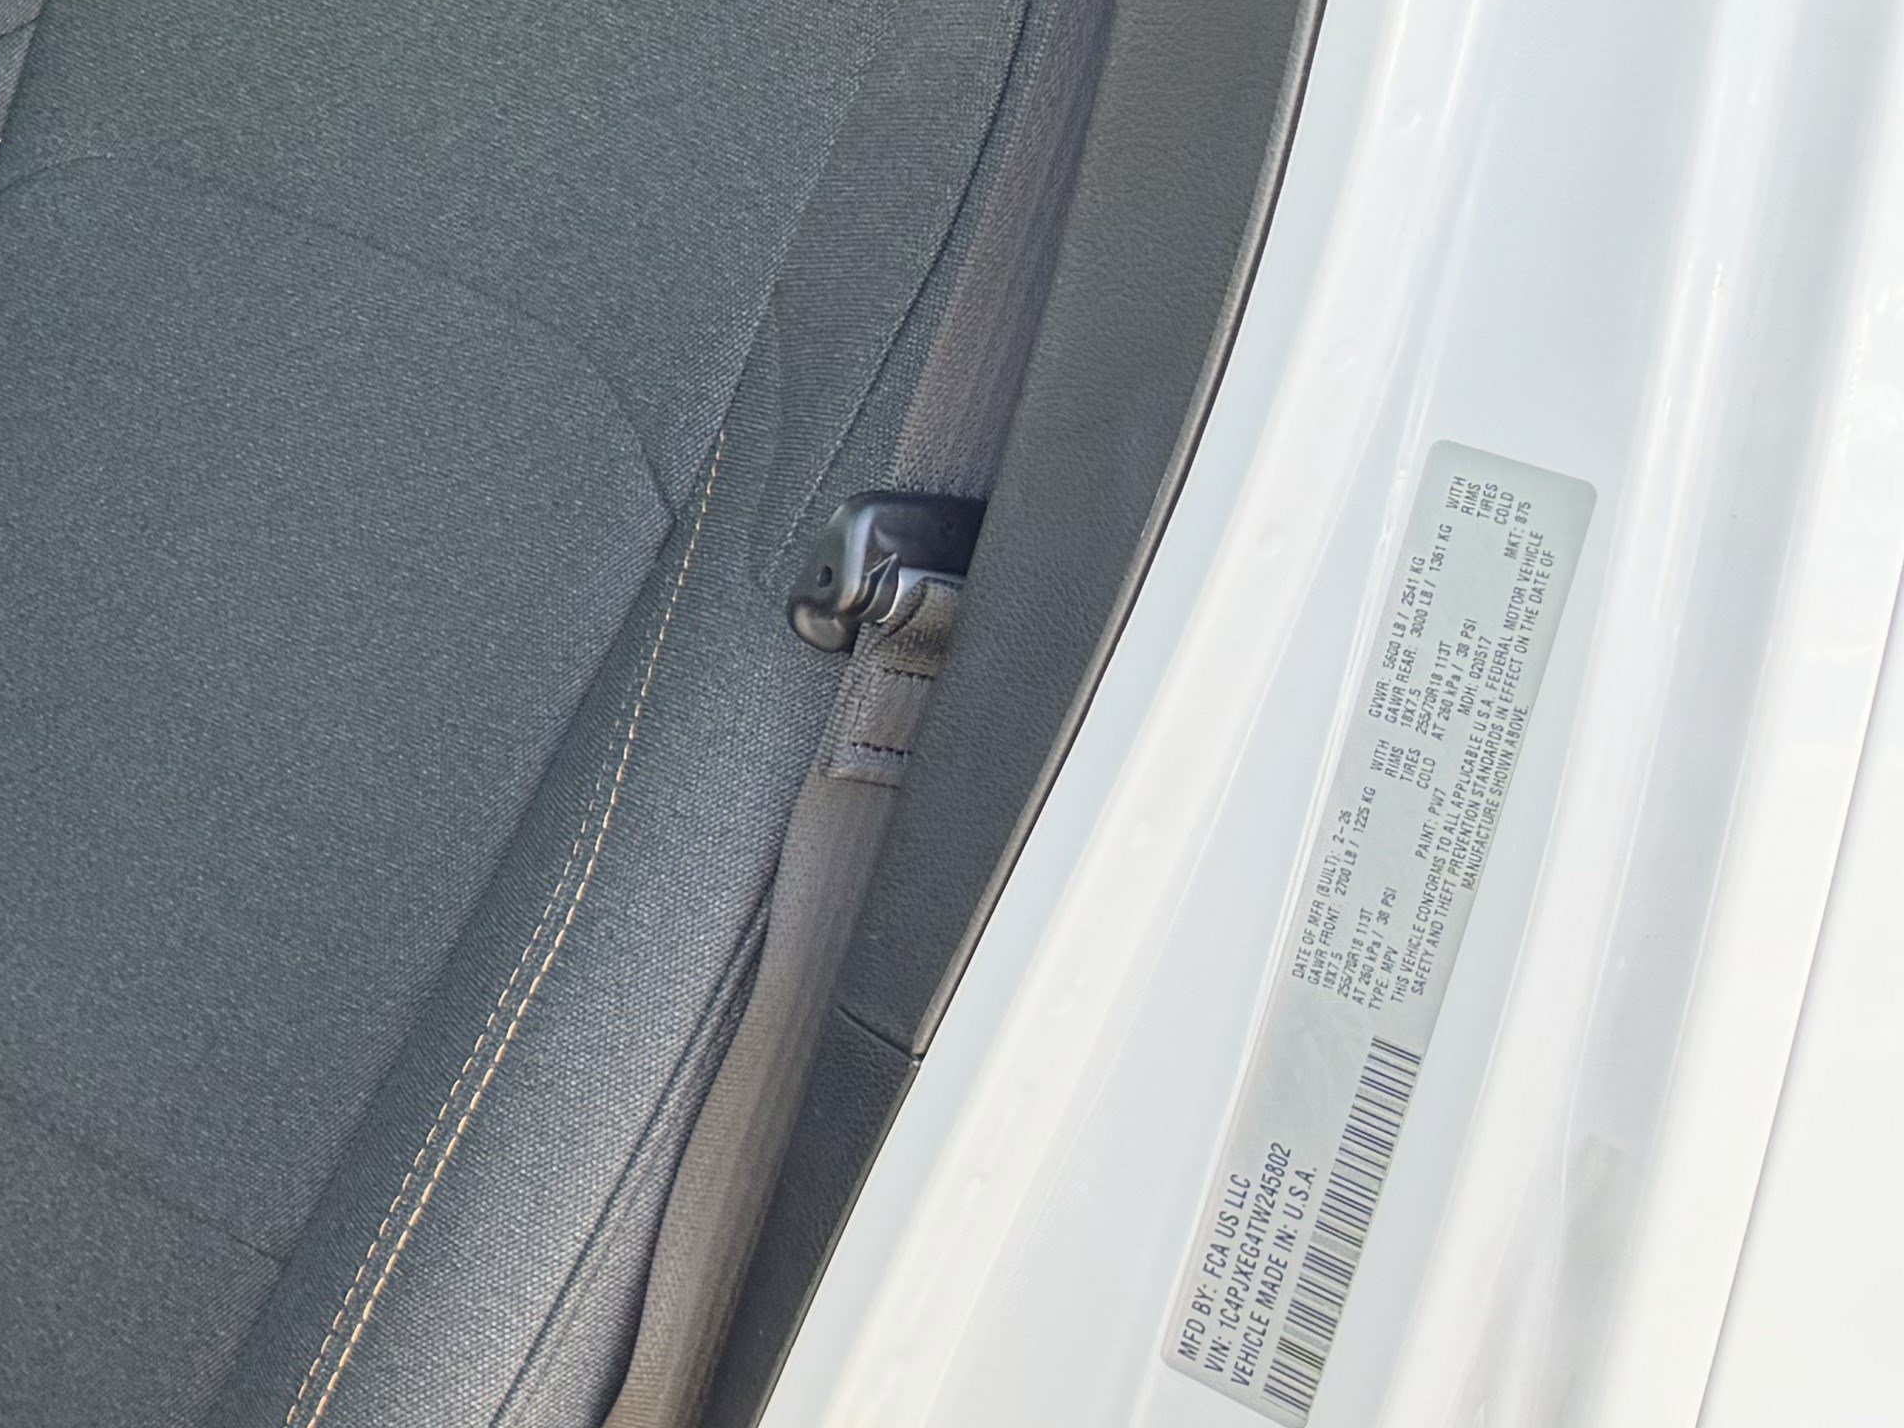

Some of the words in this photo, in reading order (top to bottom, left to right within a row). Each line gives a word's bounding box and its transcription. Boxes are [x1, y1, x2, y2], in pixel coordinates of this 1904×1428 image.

[1443, 474, 1467, 511] WITH
[1459, 480, 1482, 516] RIMS
[1475, 480, 1500, 521] TIRES
[1436, 521, 1454, 543] KG
[1501, 523, 1525, 560] MKT:
[1408, 554, 1428, 576] KG
[1426, 543, 1448, 574] 1361
[1515, 528, 1544, 584] VEHICLE
[1537, 547, 1557, 569] OF
[1399, 575, 1421, 607] 2541
[1417, 587, 1435, 606] LB
[1526, 567, 1551, 605] DATE
[1407, 606, 1429, 639] 3000
[1429, 720, 1447, 742] AT
[1459, 616, 1479, 641] PSI
[1491, 489, 1516, 526] COLD
[1501, 584, 1528, 631] MOTOR
[1518, 604, 1540, 633] THE
[1389, 620, 1408, 639] LB
[1512, 633, 1531, 655] ON
[1483, 631, 1514, 691] FEDERAL
[1497, 655, 1525, 704] EFFECT
[1381, 684, 1406, 725] GAWR
[1456, 680, 1479, 716] MDH:
[1493, 704, 1510, 721] IN
[1368, 736, 1390, 773] WITH
[1383, 744, 1405, 778] RIMS
[1398, 745, 1422, 784] TIRES
[1448, 733, 1484, 810] APPLICABLE
[1469, 720, 1505, 799] STANDARDS
[1360, 784, 1377, 805] KG
[1351, 803, 1372, 835] 1225
[1440, 808, 1461, 835] ALL
[1444, 797, 1482, 877] PREVENTION
[1458, 796, 1501, 891] MANUFACTURE
[1487, 747, 1516, 798] SHOWN
[1341, 847, 1358, 866] LB
[1413, 816, 1438, 860] PAINT:
[1434, 834, 1453, 855] TO
[1332, 865, 1353, 897] 2700
[1349, 985, 1367, 1006] AT
[1379, 885, 1398, 908] PSI
[1414, 755, 1437, 791] COLD
[1413, 853, 1447, 924] CONFORMS
[1432, 877, 1457, 918] THEFT
[1305, 898, 1327, 928] MFR
[1299, 926, 1318, 947] OF
[1397, 922, 1426, 975] VEHICLE
[1422, 917, 1445, 949] AND
[1289, 945, 1312, 980] DATE
[1305, 946, 1329, 986] GAWR
[1366, 974, 1390, 1013] TYPE:
[1378, 943, 1399, 974] MPV
[1408, 947, 1435, 997] SAFETY
[1388, 972, 1410, 1005] THIS
[1221, 1170, 1252, 1211] LLC
[1280, 1158, 1318, 1223] U.S.A.
[1212, 1207, 1241, 1241] US
[1215, 1138, 1292, 1335] 1C4PJXEG4TW245802
[1270, 1220, 1299, 1254] IN:
[1200, 1237, 1232, 1281] FCA
[1189, 1279, 1219, 1318] BY:
[1253, 1250, 1289, 1312] MADE
[1176, 1314, 1208, 1363] MFD
[1202, 1331, 1234, 1376] VIN:
[1229, 1308, 1272, 1390] VEHICLE
